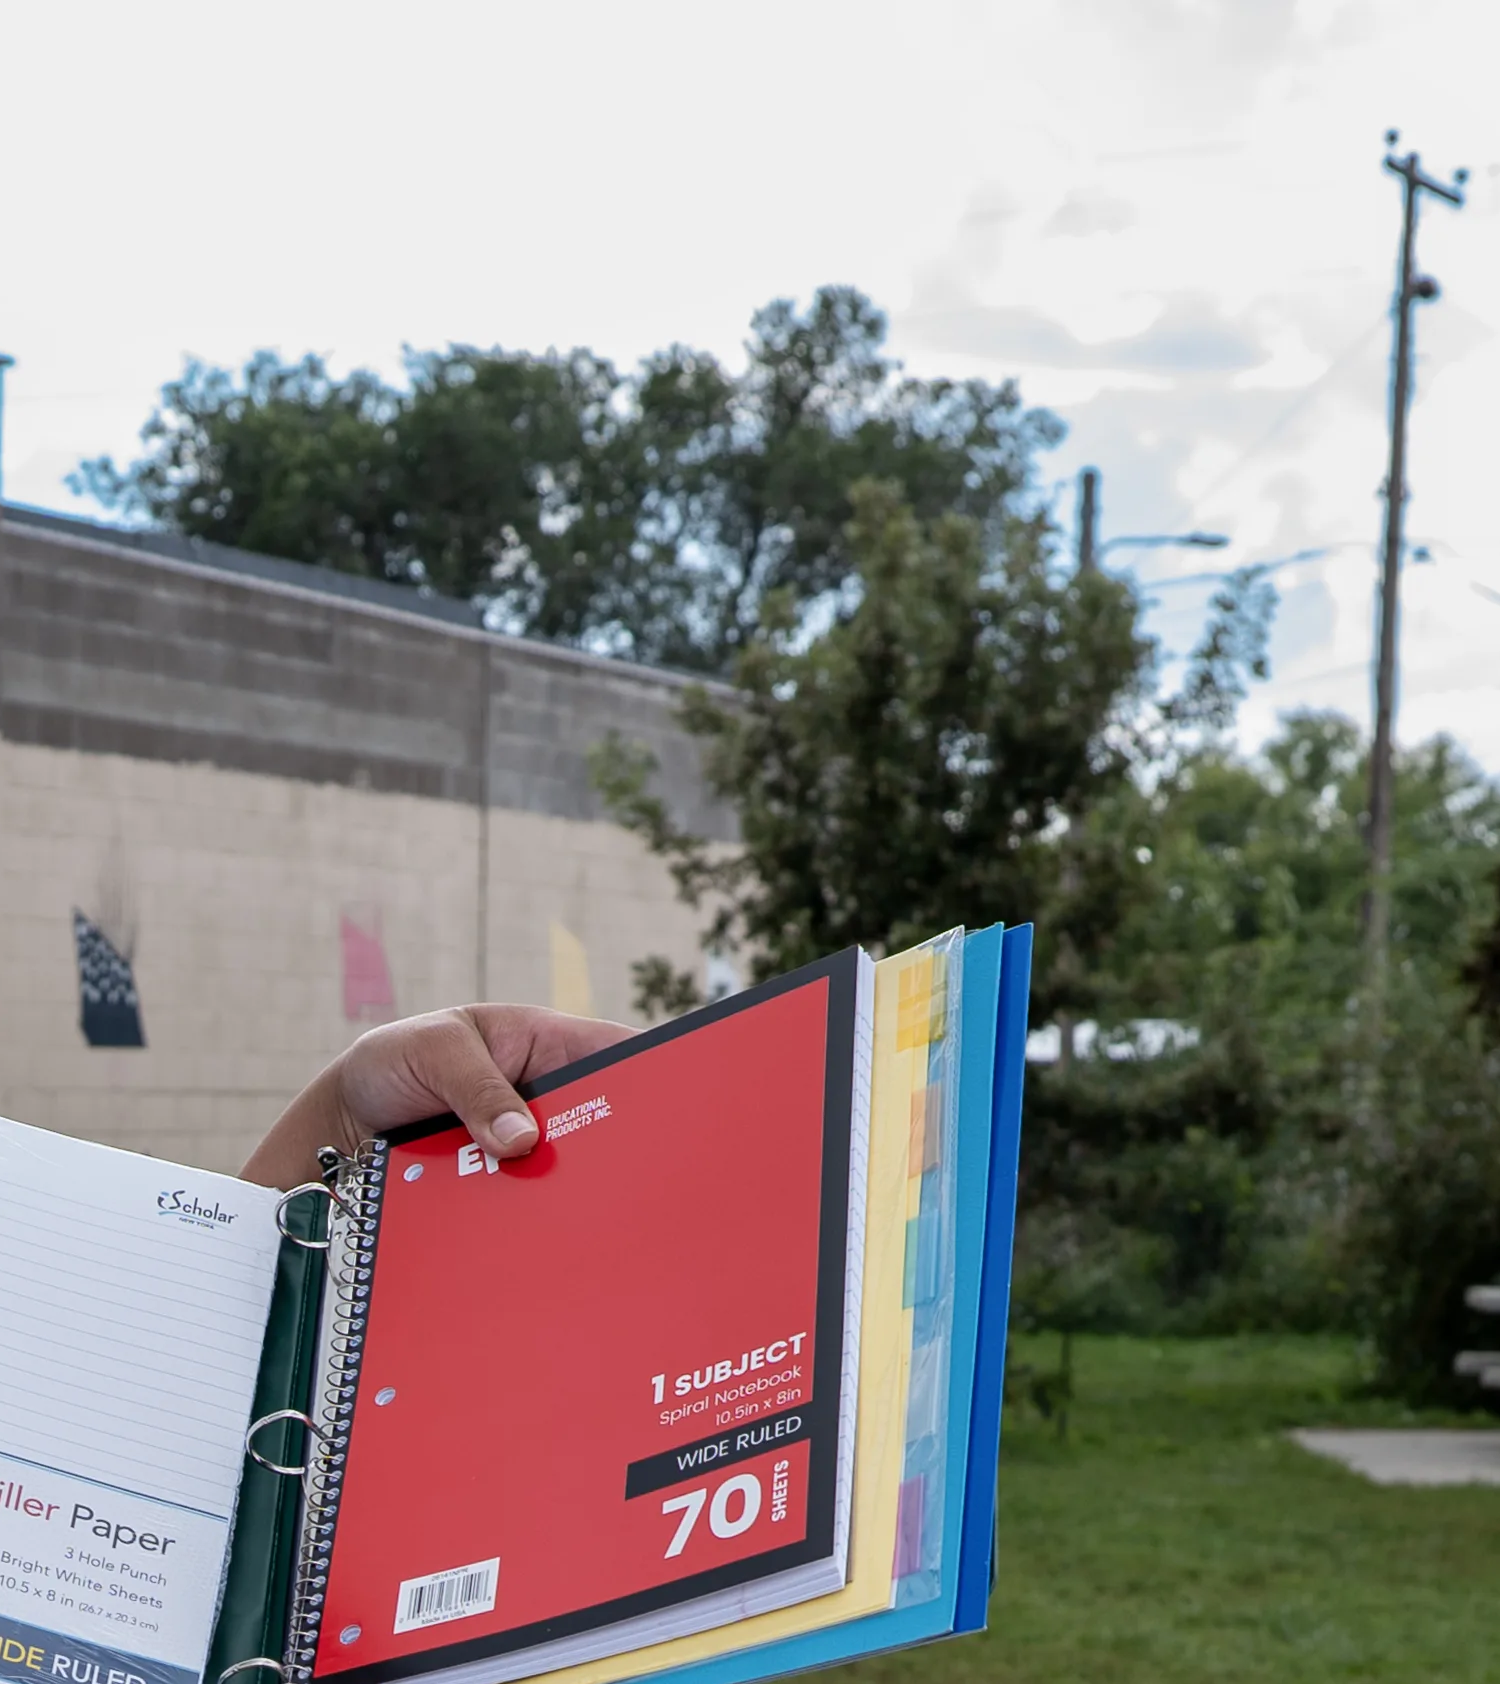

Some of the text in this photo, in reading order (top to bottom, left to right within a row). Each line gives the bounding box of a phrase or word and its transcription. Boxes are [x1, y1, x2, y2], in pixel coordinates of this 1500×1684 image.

[546, 1105, 612, 1143] PRODUCTS INC.
[547, 1095, 608, 1130] EDUCATIONAL
[652, 1332, 807, 1405] 1 SUBJECT
[660, 1365, 802, 1425] Spiral Notebook
[716, 1388, 802, 1426] 10.5in x 8in
[677, 1415, 802, 1471] WIDE RULED
[662, 1473, 763, 1559] 70
[771, 1460, 789, 1522] SHEETS
[70, 1503, 176, 1555] Paper
[0, 1550, 163, 1609] Bright White Sheets
[64, 1547, 168, 1586] 3 Hole Punch
[33, 1587, 43, 1598] x
[46, 1589, 56, 1602] 8
[60, 1593, 74, 1608] in
[78, 1602, 103, 1617] (26.7
[114, 1611, 138, 1626] 20.3
[139, 1620, 160, 1633] cm)
